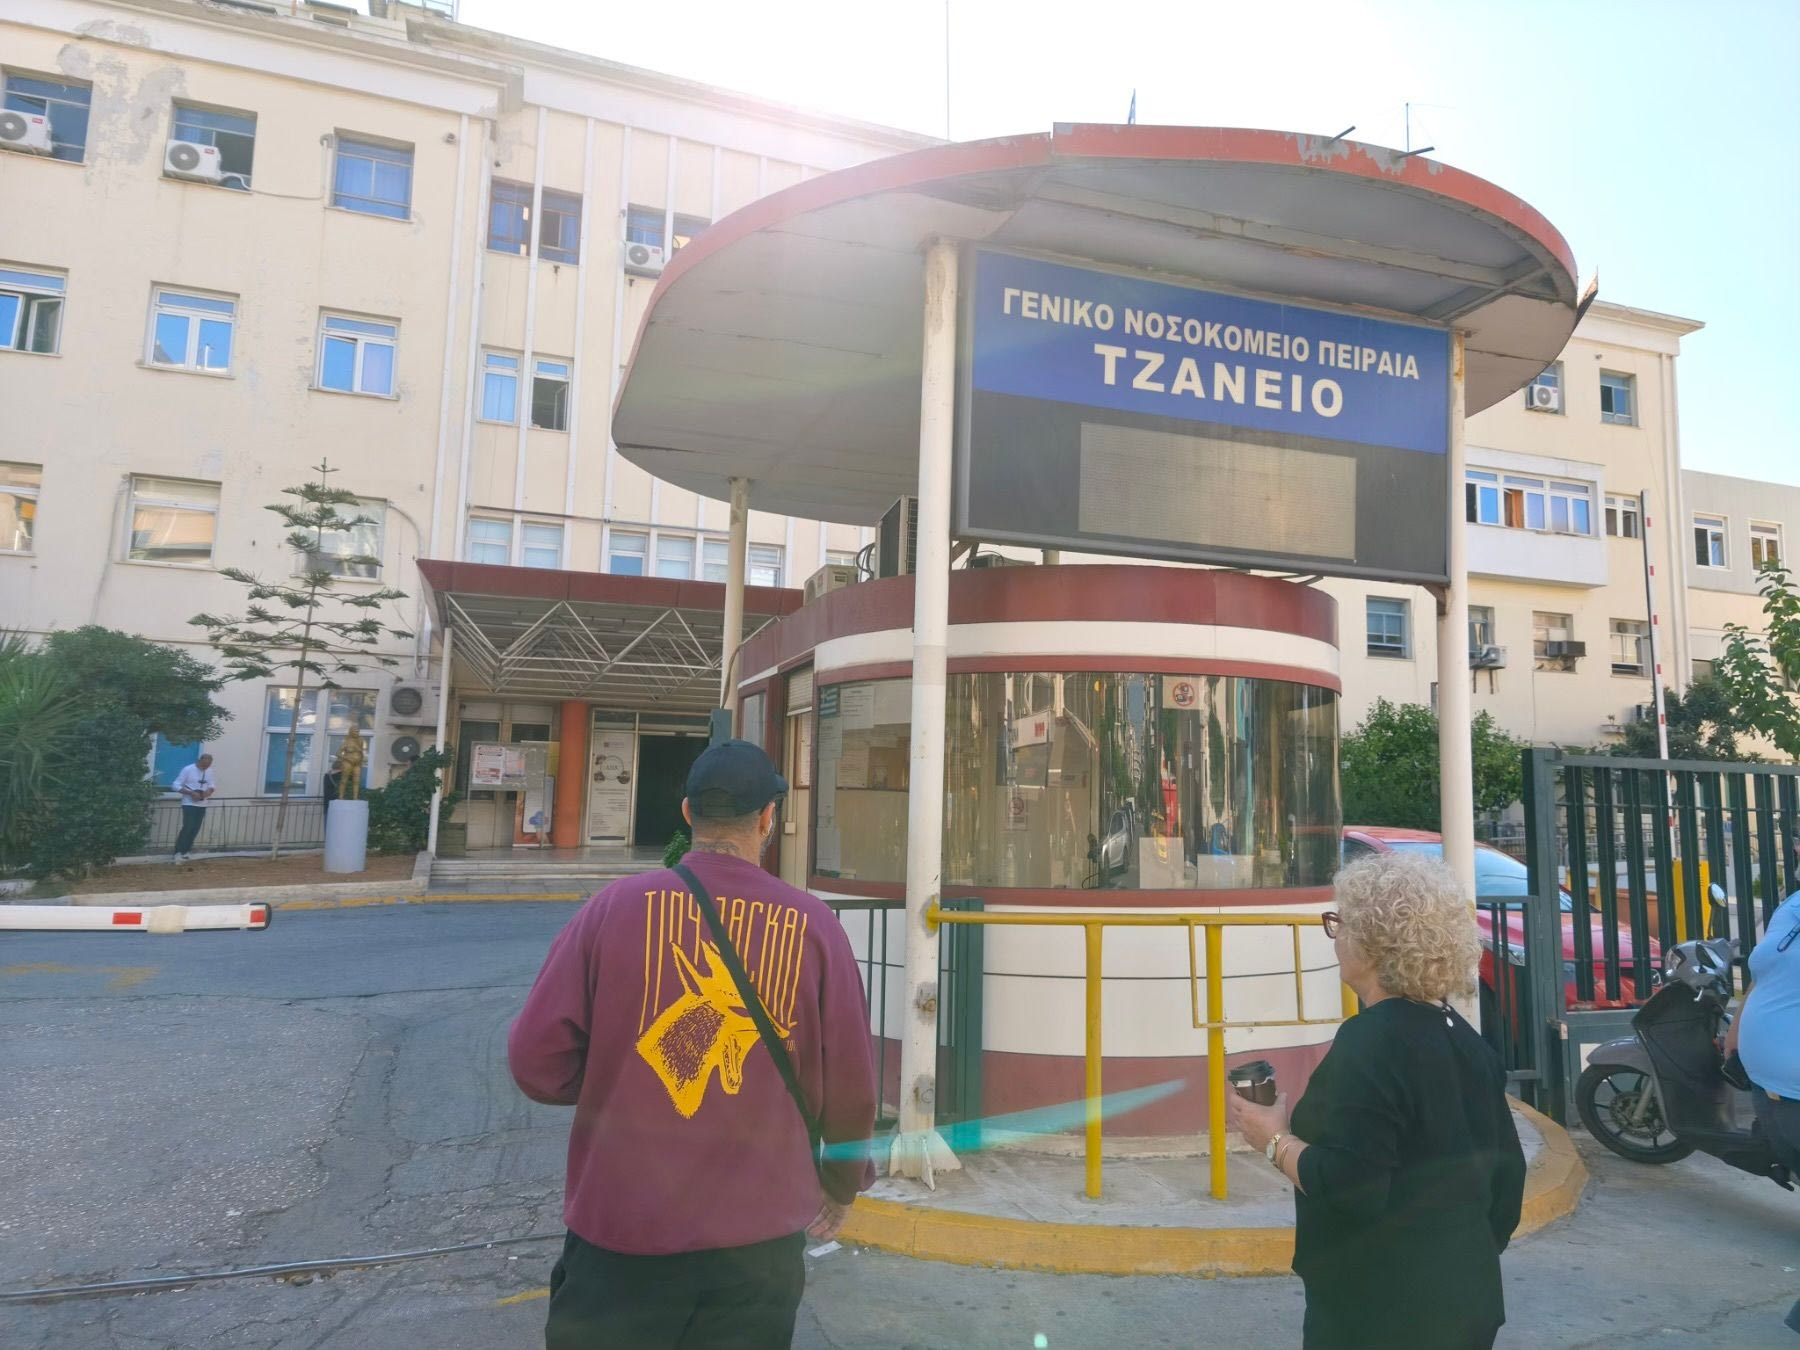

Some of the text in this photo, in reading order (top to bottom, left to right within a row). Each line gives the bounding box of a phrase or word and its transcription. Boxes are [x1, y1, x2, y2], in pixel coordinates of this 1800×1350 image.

[1003, 287, 1419, 380] ΓΕΝΙΚΟ ΝΟΣΟΚΟΜΕΙΟ ΠΕΙΡΑΙΑ
[1093, 343, 1344, 418] ΤΖΑΝΕΙΟ
[639, 890, 702, 1036] TINY
